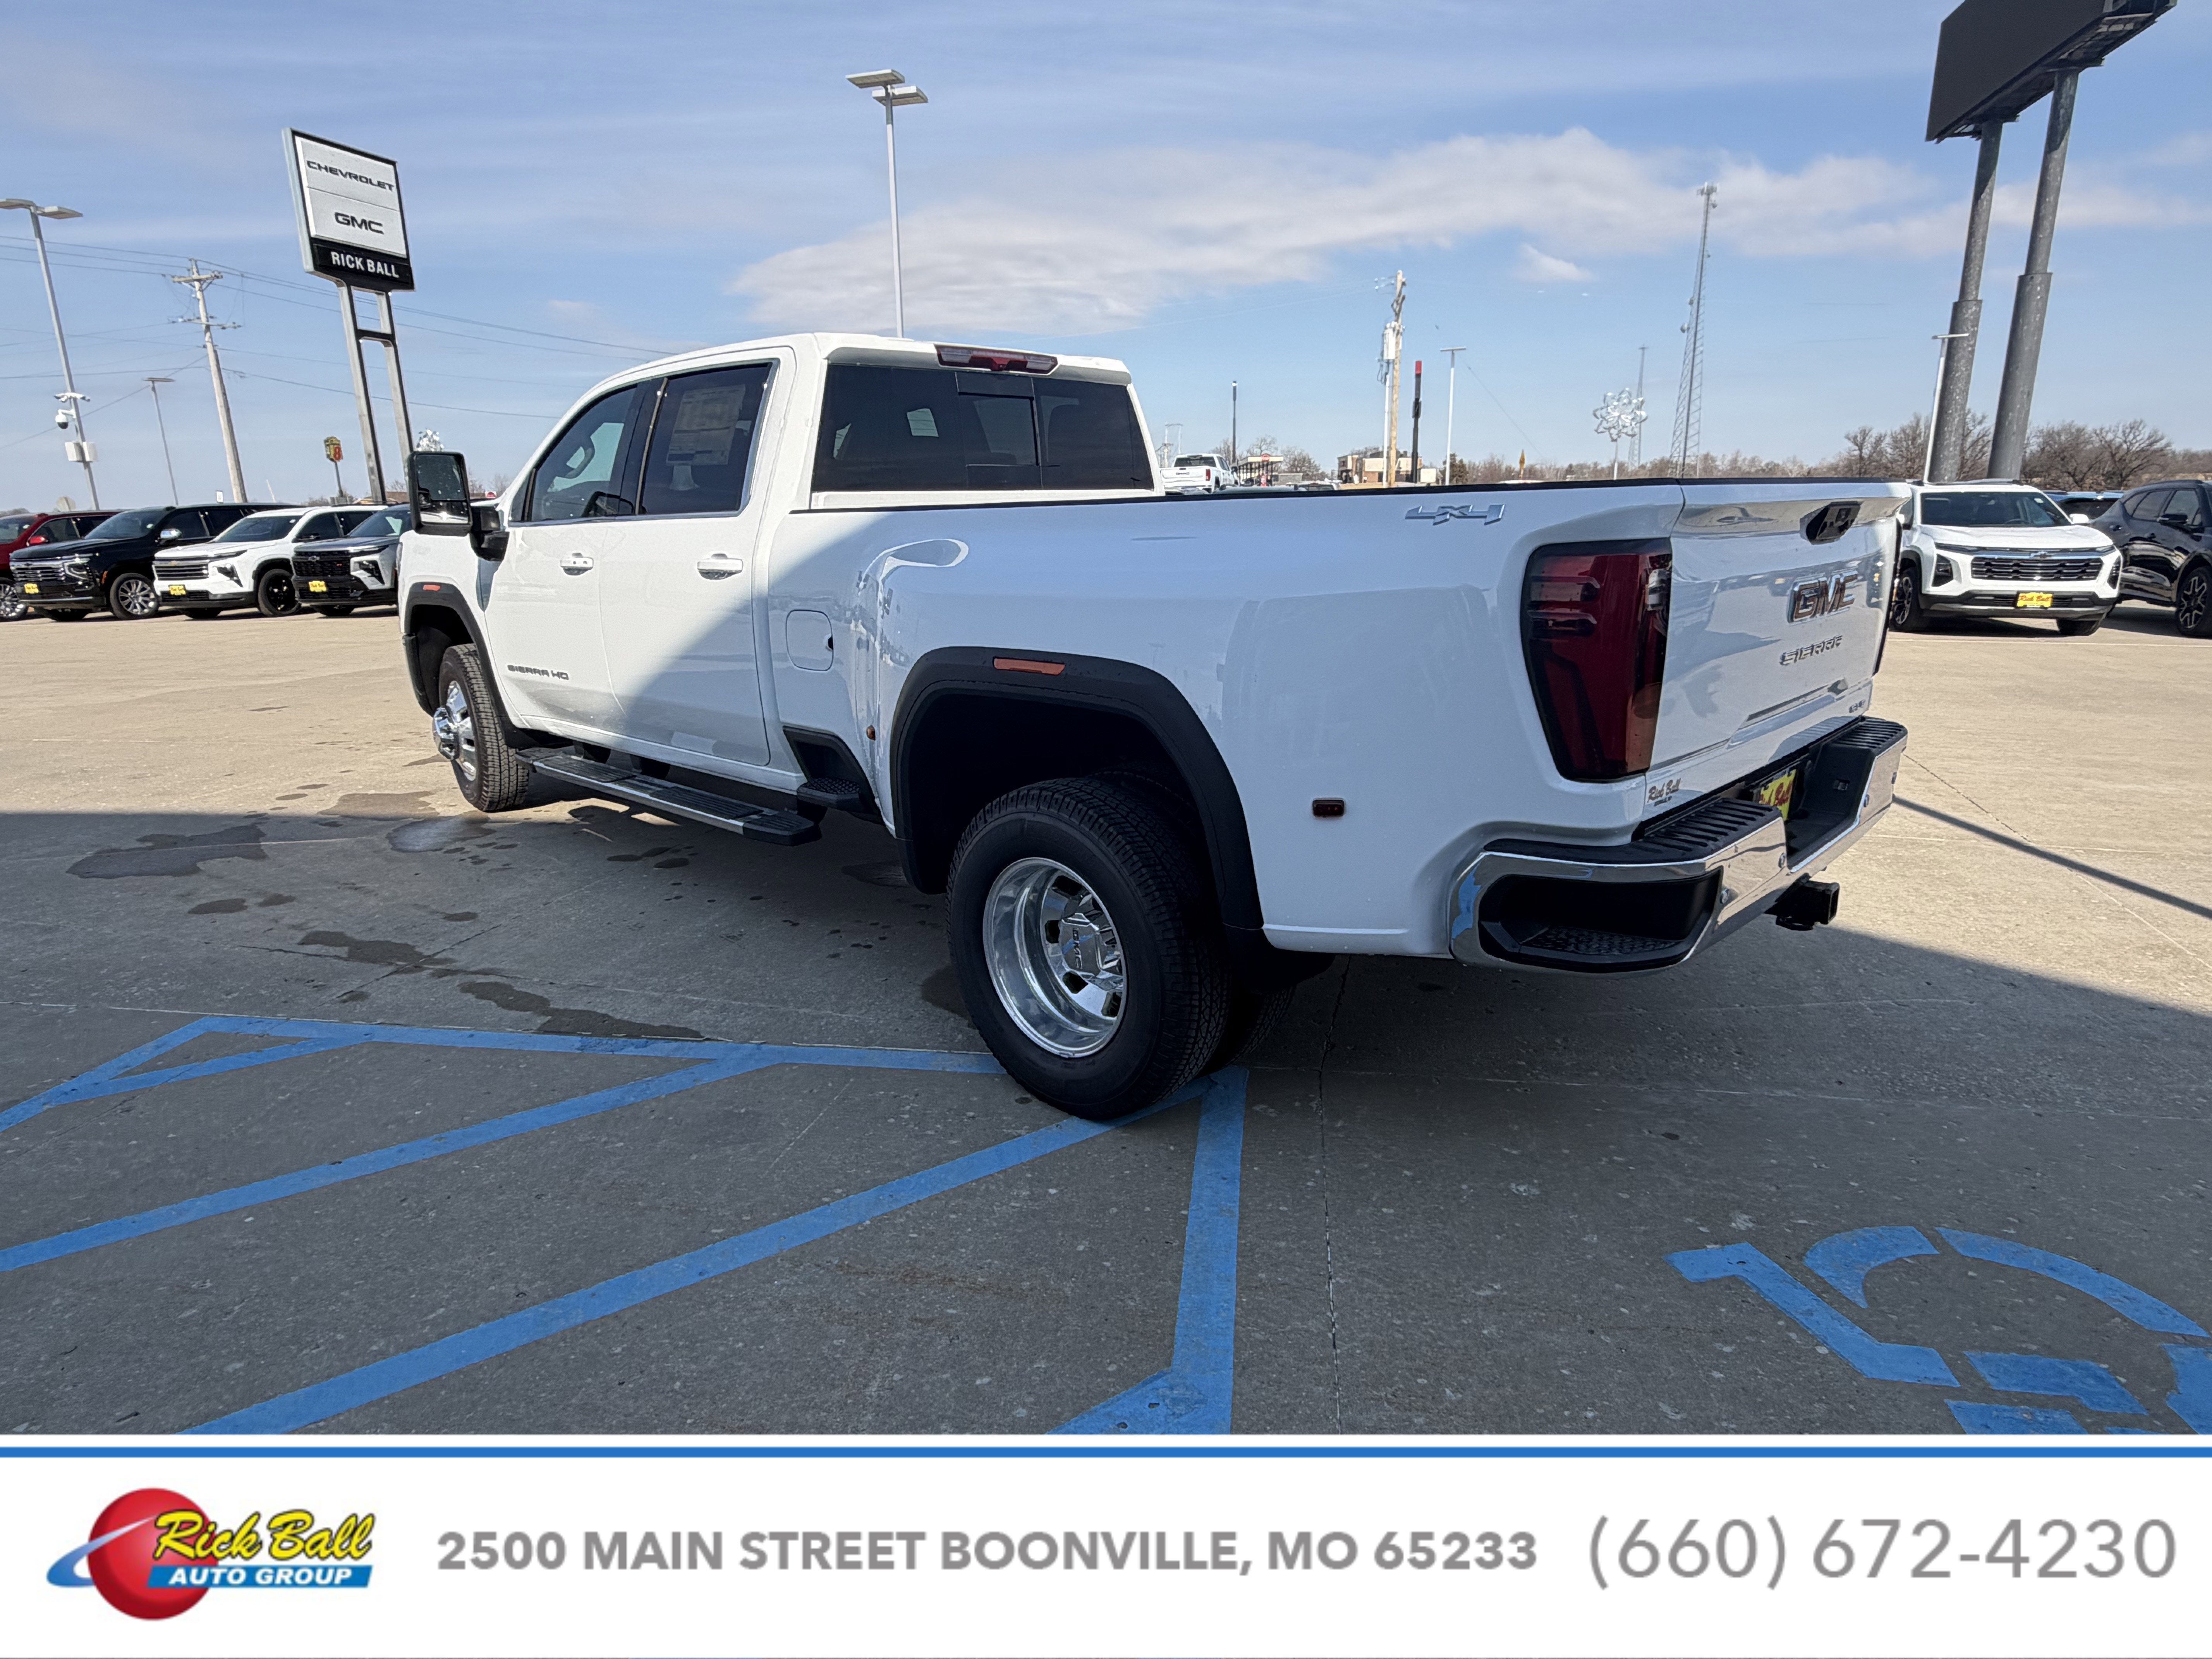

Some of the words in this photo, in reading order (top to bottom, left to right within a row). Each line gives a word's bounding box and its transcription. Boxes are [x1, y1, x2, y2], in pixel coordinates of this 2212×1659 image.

[306, 160, 394, 192] CHEVROLET
[334, 212, 384, 234] GMC
[331, 251, 364, 271] RICK
[366, 259, 400, 278] BALL
[1788, 570, 1858, 624] GMC
[1779, 635, 1843, 666] SIERRA
[507, 665, 550, 677] SIERRA
[551, 670, 569, 680] HD
[1073, 928, 1082, 969] GMC
